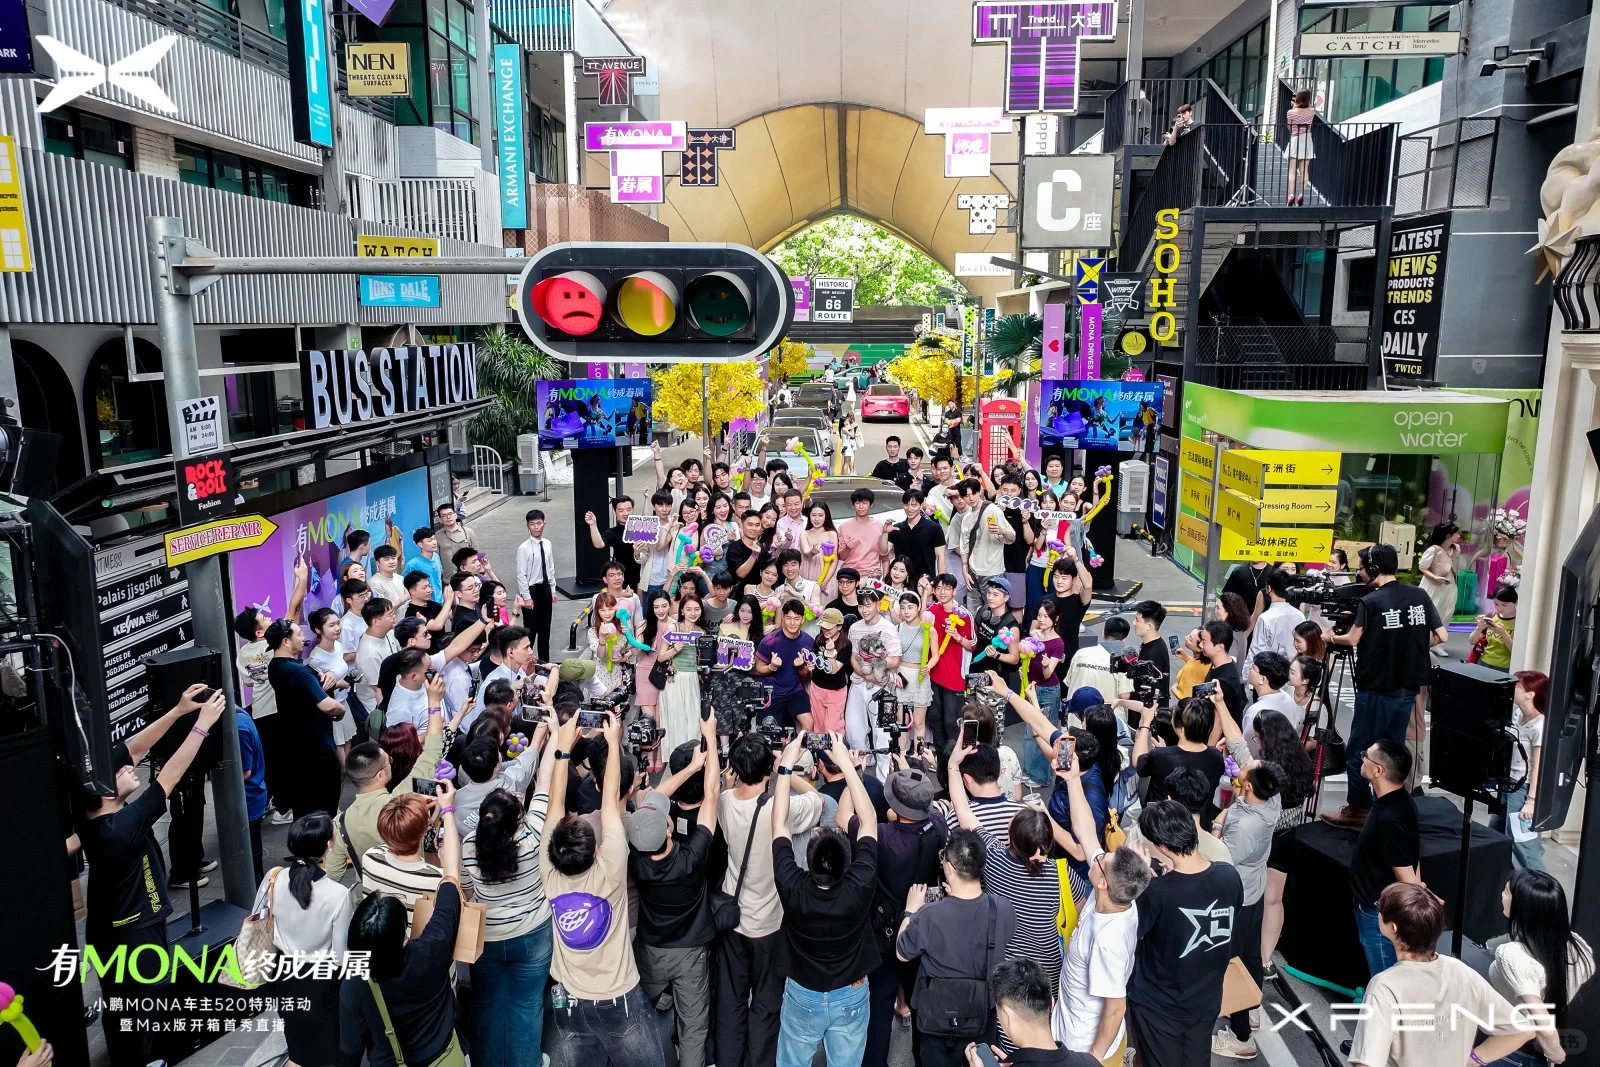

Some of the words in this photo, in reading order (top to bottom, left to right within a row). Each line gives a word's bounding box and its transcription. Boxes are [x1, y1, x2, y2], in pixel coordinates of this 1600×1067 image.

[1071, 12, 1102, 29] 大道
[1325, 41, 1402, 51] CATCH
[352, 53, 395, 71] NEN
[602, 61, 640, 71] AVENUE
[501, 58, 515, 141] EXCHANGE
[504, 145, 519, 207] ARMANI
[1392, 229, 1443, 252] LATEST
[1149, 207, 1181, 342] SOHO
[1389, 254, 1438, 278] NEWS
[1387, 277, 1434, 290] PRODUCTS
[825, 299, 842, 310] 66
[1387, 290, 1433, 304] TRENDS
[1393, 309, 1416, 325] CES
[1088, 316, 1096, 341] MONA
[1382, 331, 1429, 357] DAILY
[1087, 342, 1095, 370] DRIVES
[1394, 363, 1422, 375] TWICE
[309, 350, 373, 429] BUS
[374, 342, 478, 417] STATION
[1394, 411, 1454, 430] open
[1400, 428, 1468, 448] water
[184, 459, 227, 485] ROCK
[198, 499, 222, 511] Fashion
[1260, 501, 1290, 511] Dressing
[1291, 501, 1313, 510] Room
[170, 529, 214, 557] SERVICE
[213, 520, 263, 544] REPAIR
[883, 584, 900, 598] MON
[1381, 604, 1427, 630] 直播
[735, 639, 753, 647] DRIVES
[122, 650, 132, 661] DE
